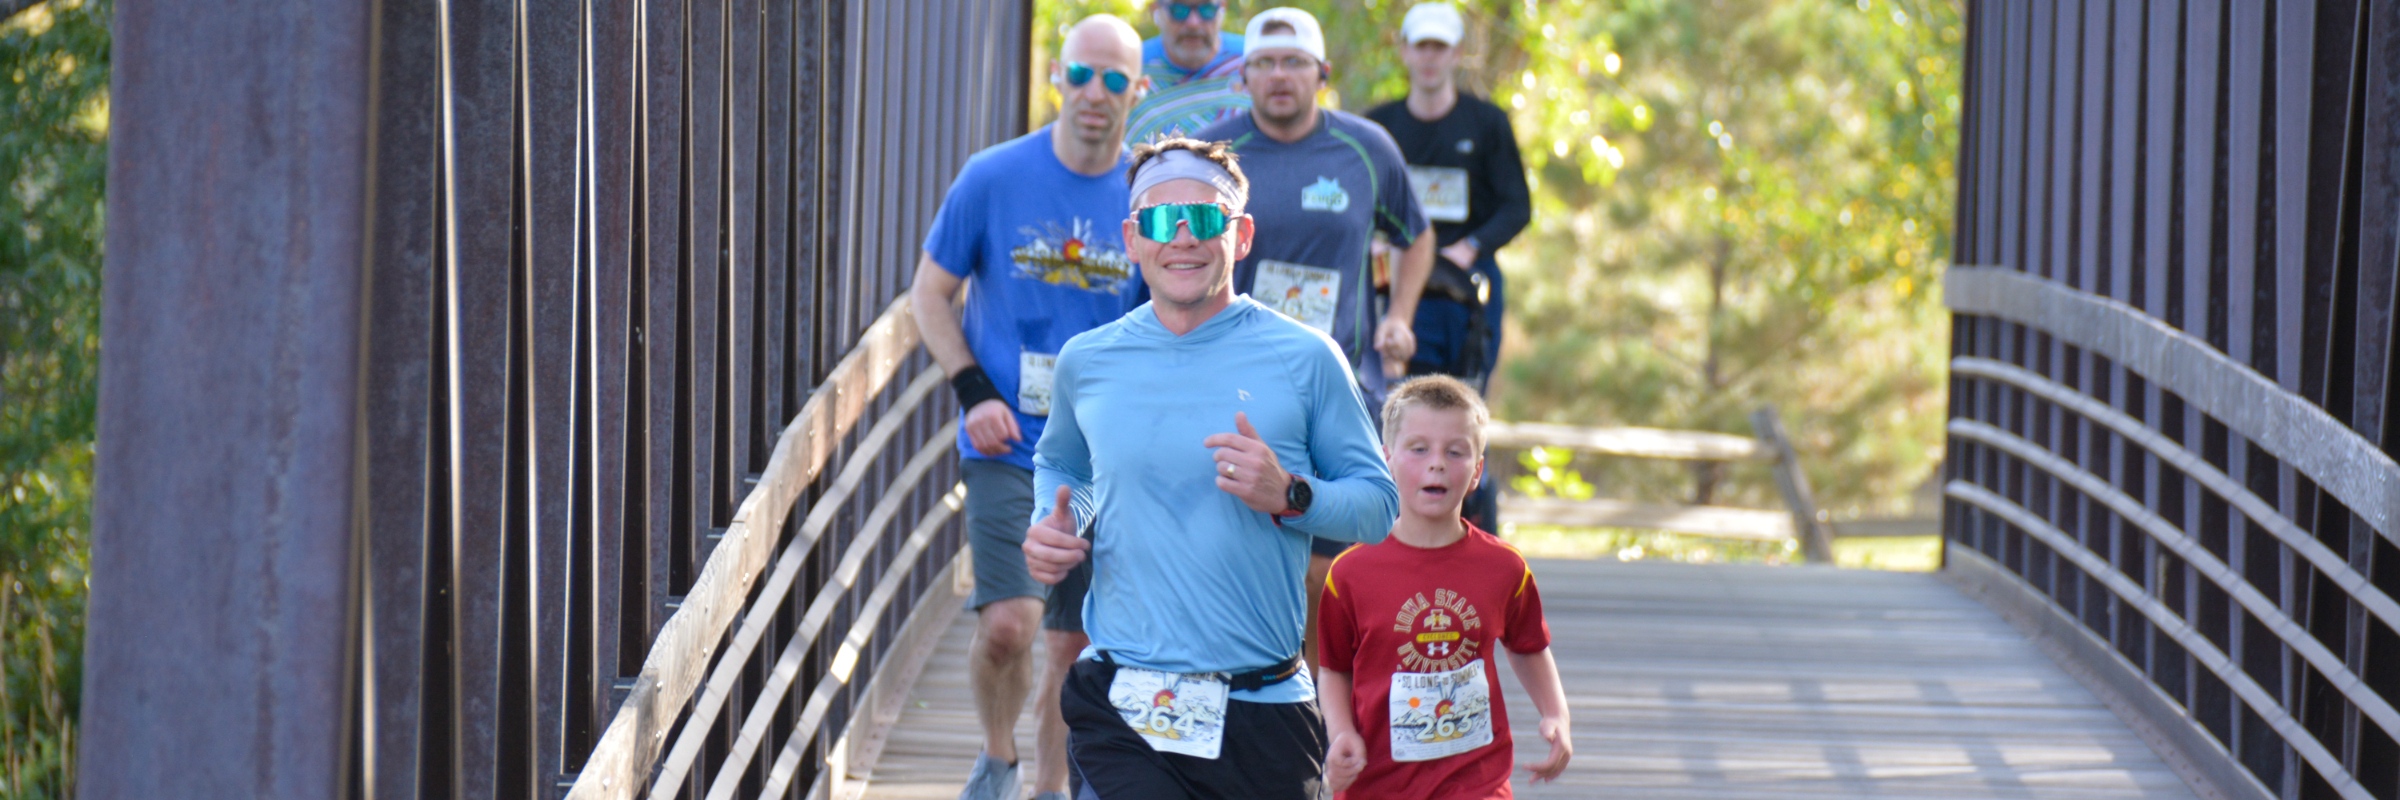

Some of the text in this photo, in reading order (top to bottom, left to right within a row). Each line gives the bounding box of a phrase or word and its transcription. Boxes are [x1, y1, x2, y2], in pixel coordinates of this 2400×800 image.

[1393, 588, 1481, 634] IOWA STATE
[1397, 637, 1480, 673] UNIVERSITY
[1415, 675, 1440, 688] LONG
[1129, 702, 1195, 737] 264
[1416, 709, 1473, 740] 263
